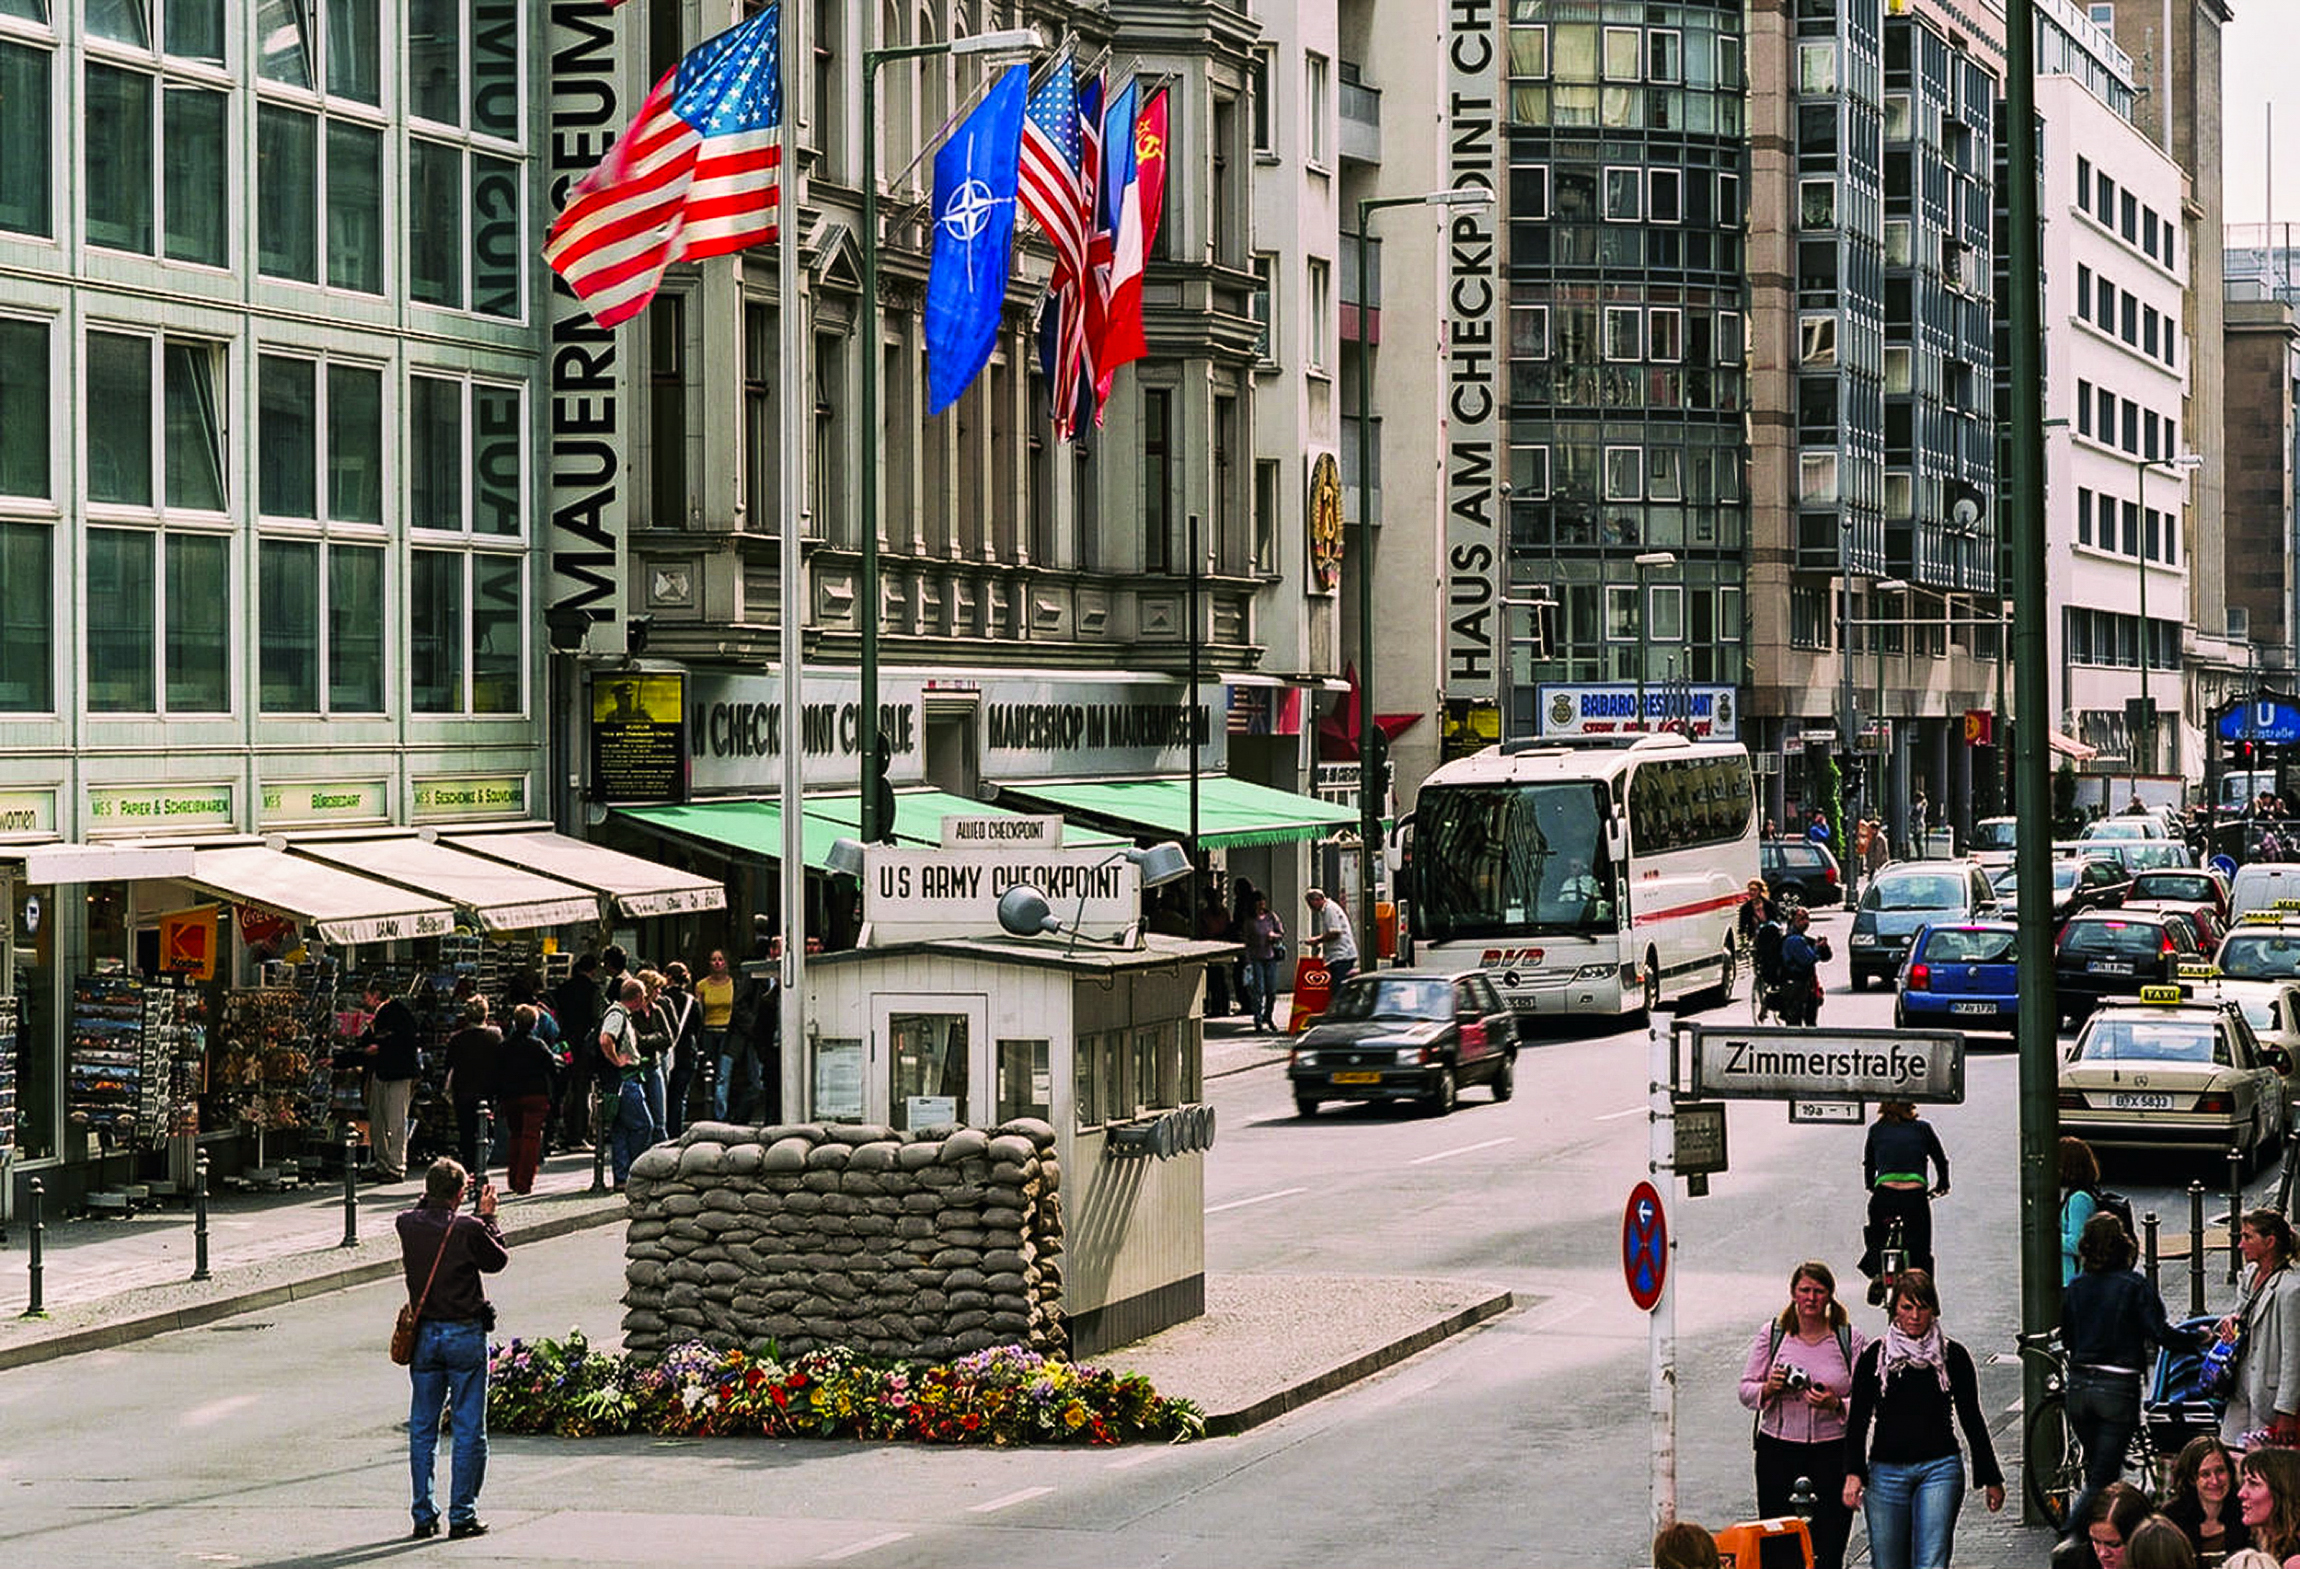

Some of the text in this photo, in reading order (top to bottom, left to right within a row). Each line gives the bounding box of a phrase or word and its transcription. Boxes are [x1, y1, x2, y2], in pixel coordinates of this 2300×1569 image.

[1450, 443, 1492, 528] AM
[1450, 545, 1492, 680] HAUS
[711, 702, 837, 757] CHECKINT
[987, 703, 1211, 750] MAUERSHOP IM MAUERMUSEM
[2234, 727, 2295, 740] Khstraße
[2257, 702, 2275, 727] U
[955, 820, 1045, 840] ALLIED CHECKPOINT
[879, 865, 911, 899] US
[921, 865, 983, 899] ARMY
[2146, 989, 2176, 1001] TAXI
[1724, 1041, 1928, 1086] Zimmerstraße
